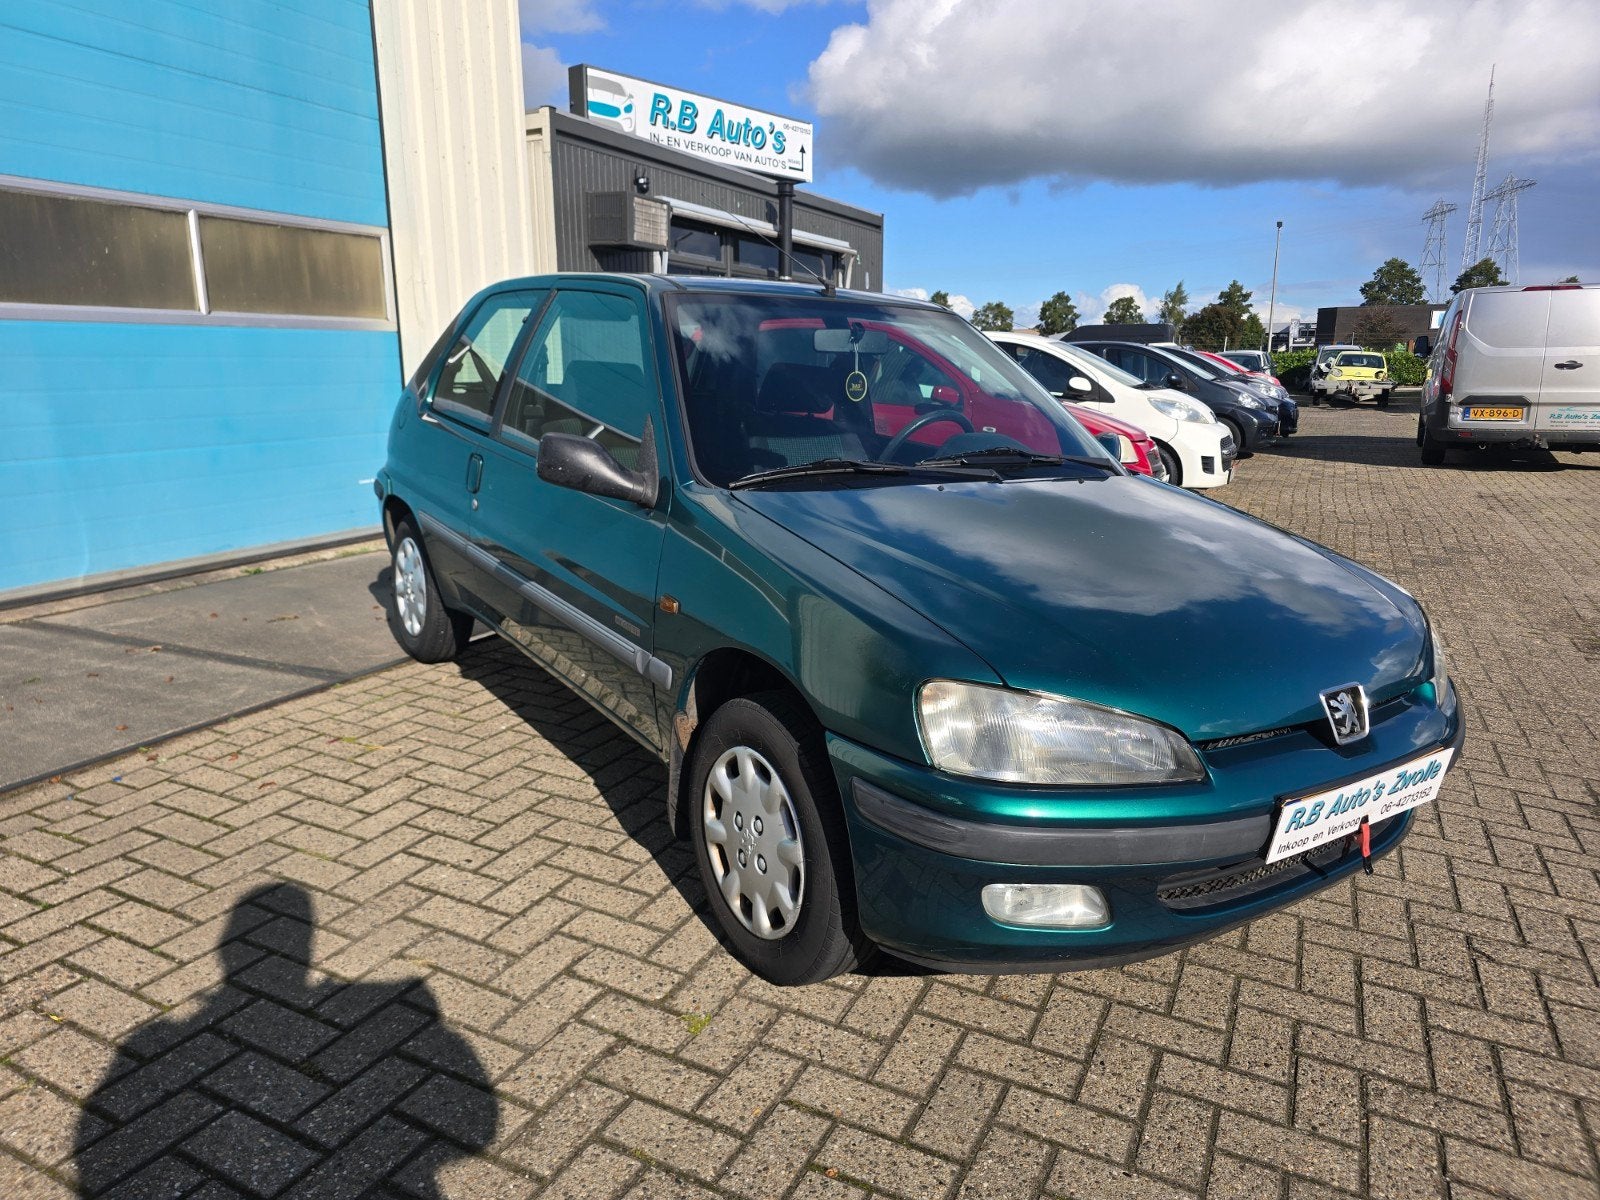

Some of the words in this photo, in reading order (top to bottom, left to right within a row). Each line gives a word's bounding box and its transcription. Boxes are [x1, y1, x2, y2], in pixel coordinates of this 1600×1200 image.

[649, 92, 698, 134] R.B
[706, 108, 786, 155] Auto's
[649, 132, 664, 144] IN-
[667, 136, 681, 147] EN
[685, 139, 732, 157] VERKOOP
[734, 150, 752, 162] VAN
[754, 155, 787, 169] AUTO'S
[1473, 409, 1519, 417] VX-896-D
[1285, 801, 1325, 833] R.B
[1325, 780, 1386, 819] Auto's
[1388, 759, 1442, 795] Zwolle
[1380, 786, 1433, 815] 06-42713152
[1277, 837, 1310, 855] Inkoop
[1313, 831, 1323, 842] en
[1327, 816, 1361, 836] Verkoop
